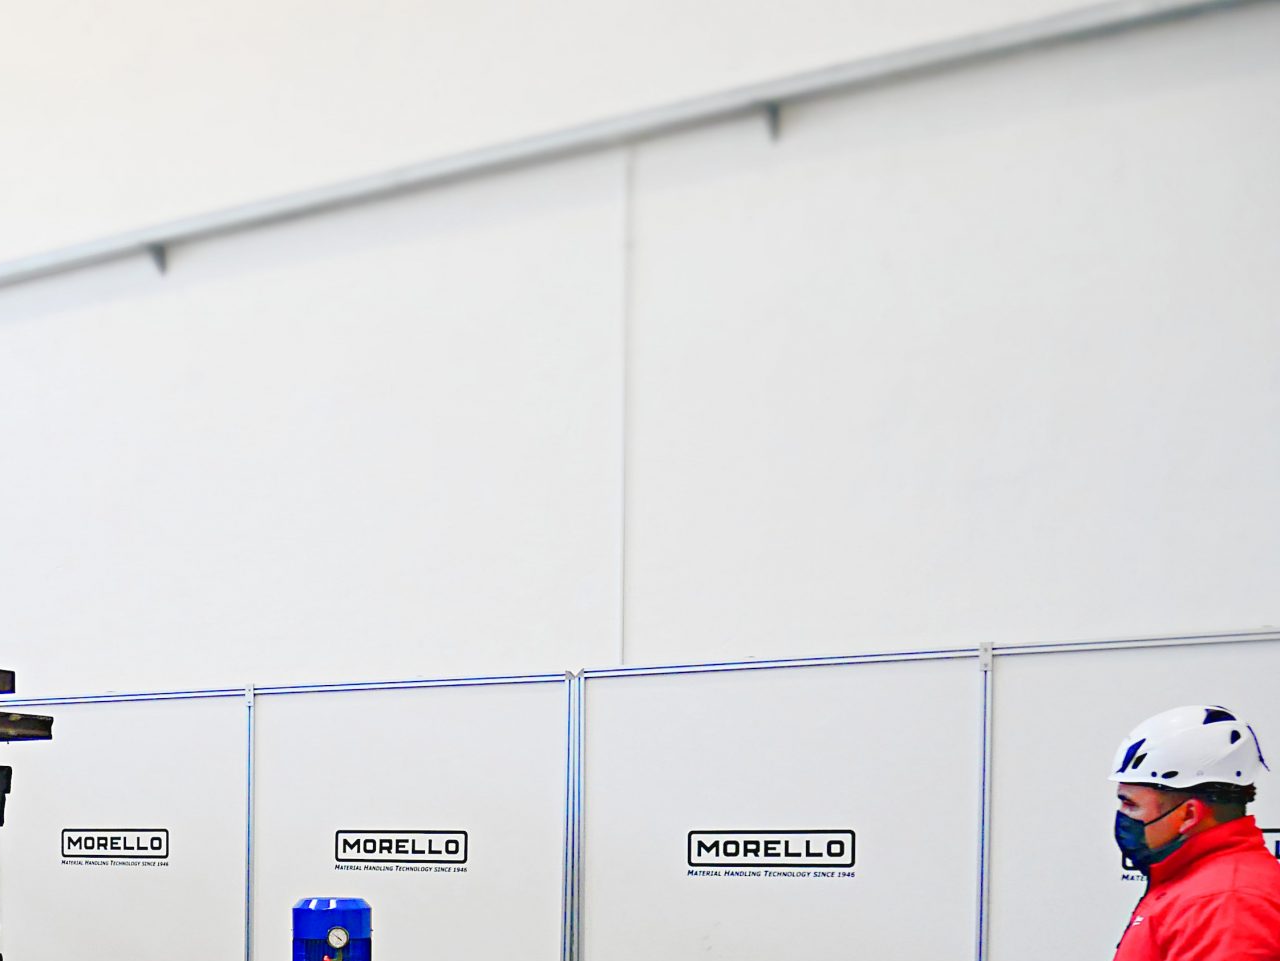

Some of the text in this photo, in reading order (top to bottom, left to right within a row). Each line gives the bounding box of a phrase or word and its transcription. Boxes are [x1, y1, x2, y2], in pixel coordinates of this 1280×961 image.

[67, 836, 162, 850] MORELLO
[342, 838, 460, 855] MORELLO
[697, 839, 845, 858] MORELLO
